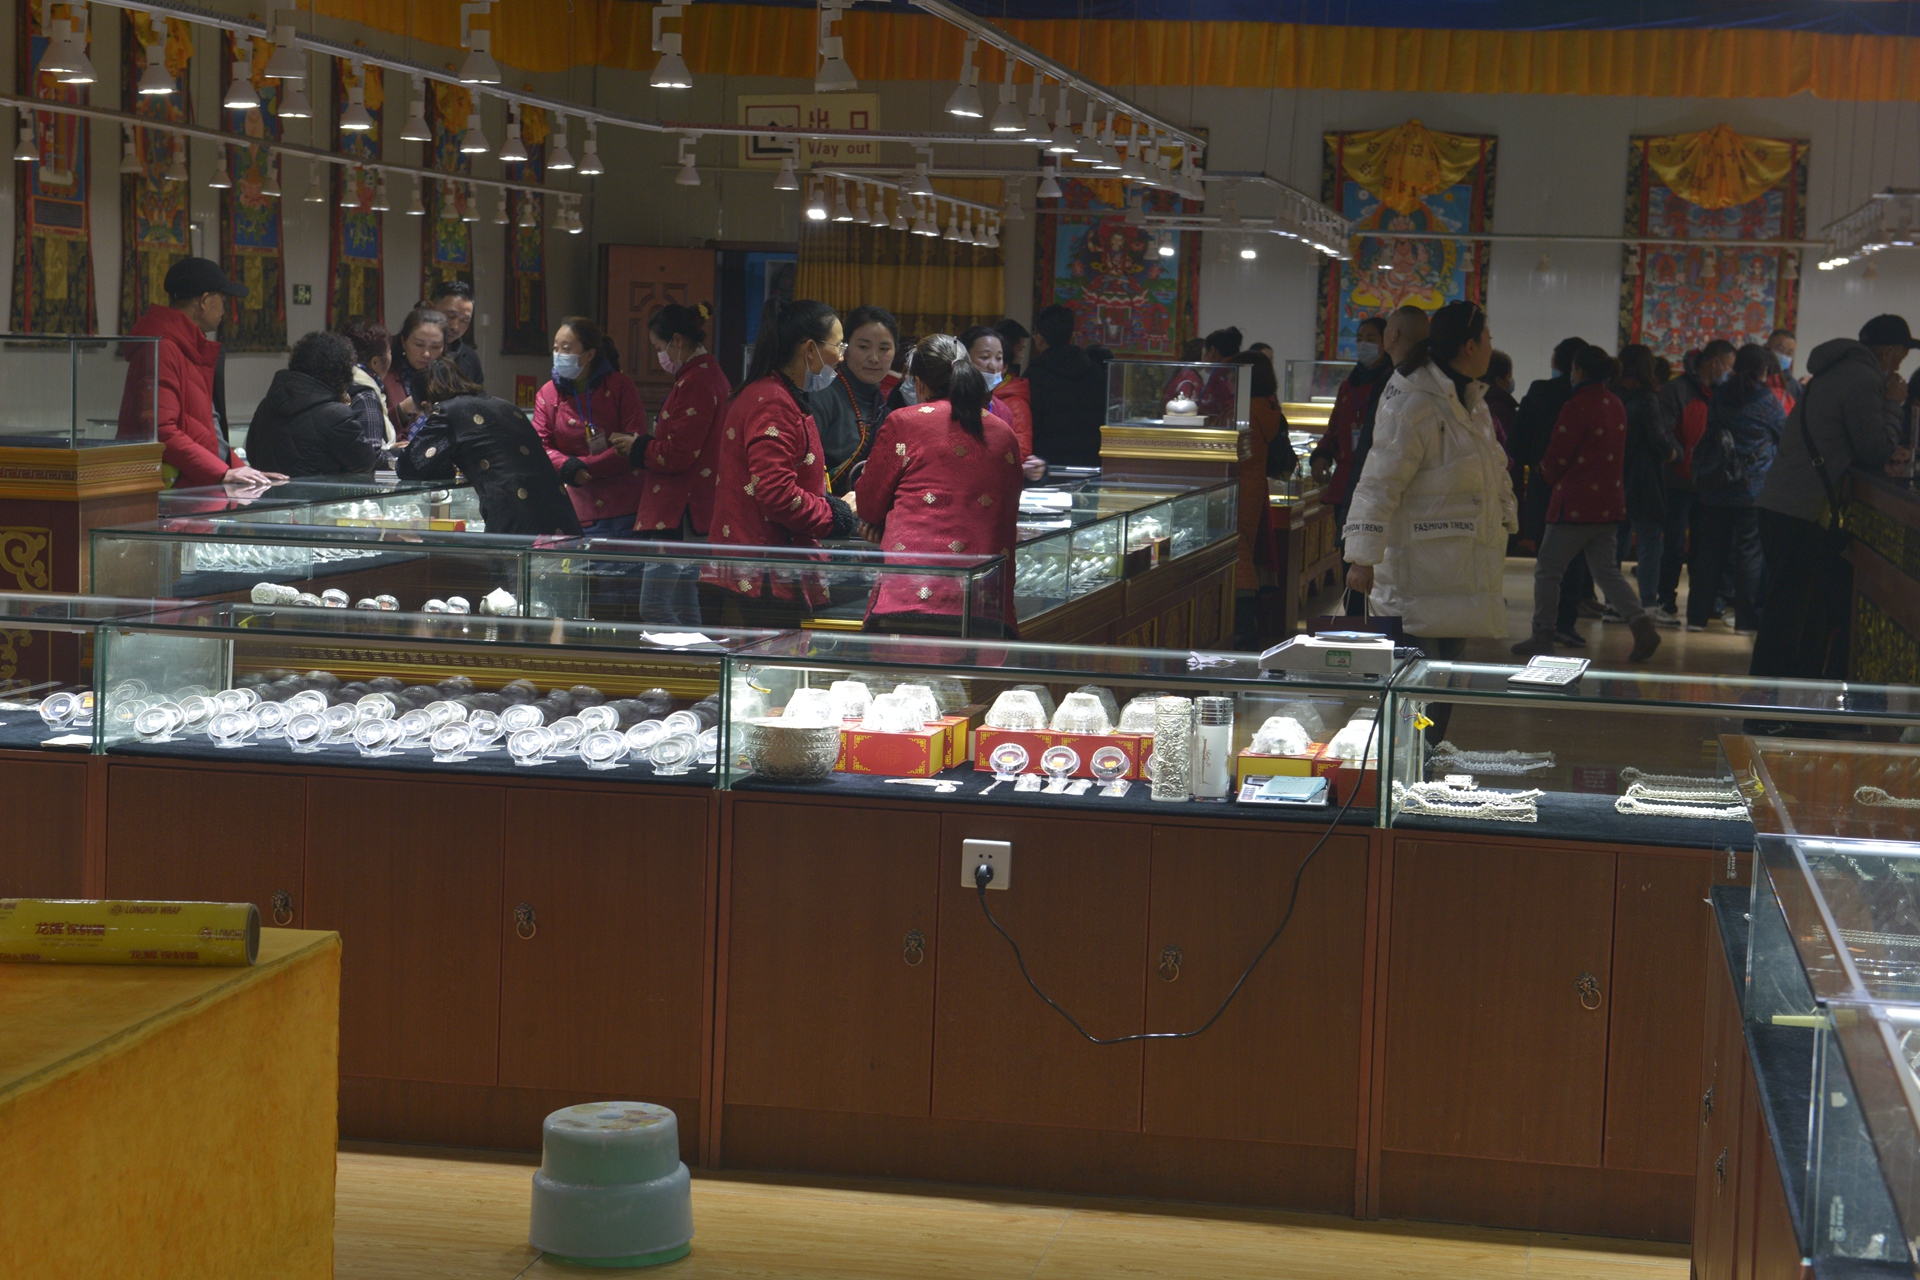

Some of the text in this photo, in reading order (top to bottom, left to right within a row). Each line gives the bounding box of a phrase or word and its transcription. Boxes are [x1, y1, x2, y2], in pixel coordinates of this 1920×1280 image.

[809, 108, 868, 130] 出口
[808, 142, 872, 157] Way out
[1361, 523, 1384, 533] TREND
[1450, 521, 1475, 531] TREND
[160, 906, 182, 915] WRAP
